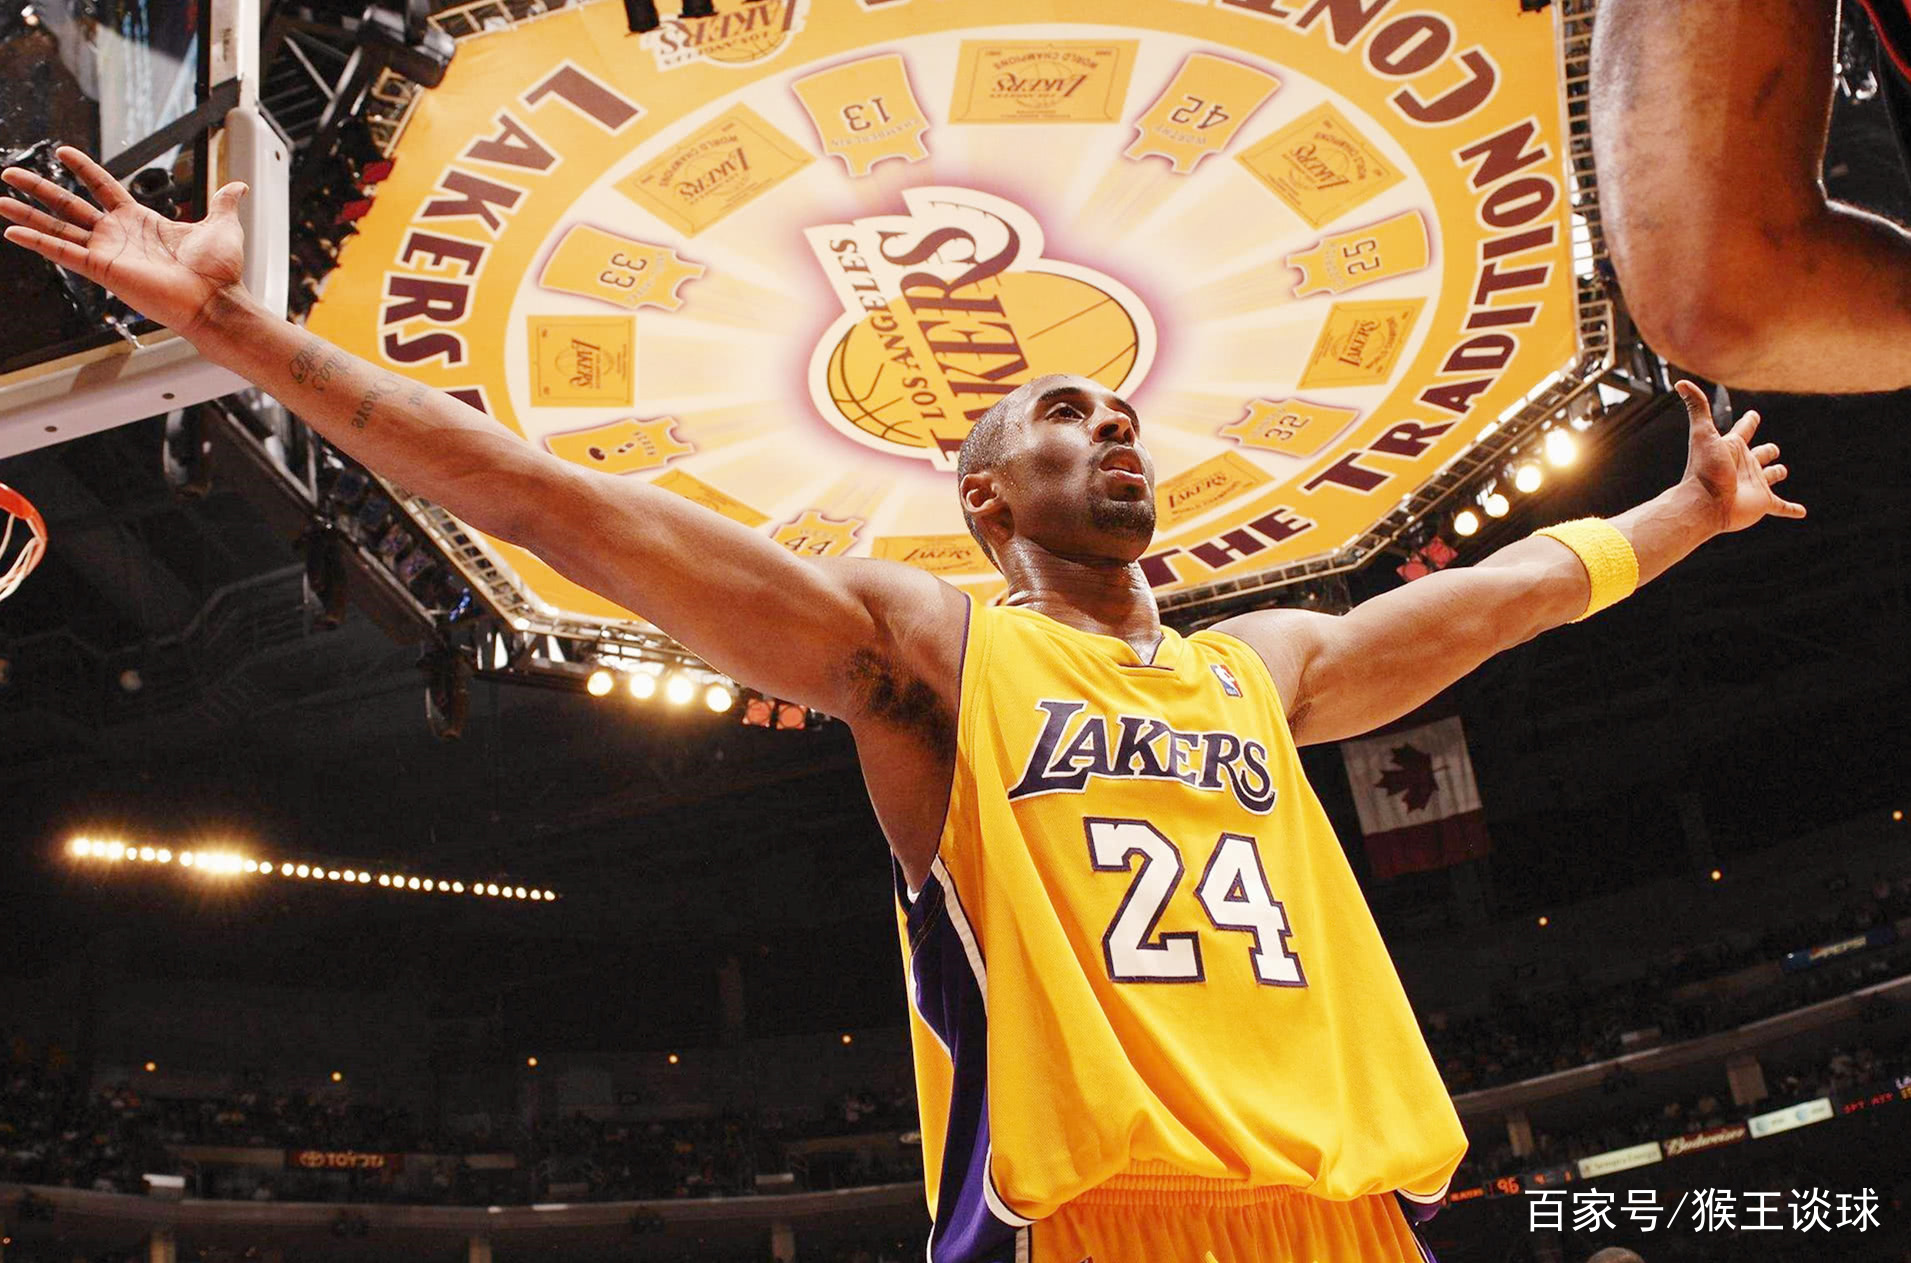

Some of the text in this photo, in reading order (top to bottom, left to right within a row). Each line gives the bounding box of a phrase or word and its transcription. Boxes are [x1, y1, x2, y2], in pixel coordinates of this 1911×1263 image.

[657, 0, 796, 52] LAKERS
[994, 72, 1088, 97] LAKERS
[842, 96, 891, 132] 13
[1171, 95, 1230, 130] 42
[675, 147, 751, 198] LAKERS
[1294, 143, 1352, 190] LAKERS
[380, 60, 645, 368] LAKERS
[599, 252, 648, 289] 33
[1343, 239, 1380, 275] 25
[830, 238, 946, 420] LOS ANGELES
[1300, 117, 1560, 494] TRADITION
[877, 199, 1029, 461] KERS
[1338, 319, 1381, 368] LAKERS
[570, 338, 601, 388] LAKERS
[1264, 414, 1310, 441] 32
[1168, 471, 1228, 508] LAKERS
[784, 535, 833, 556] 44
[1141, 505, 1317, 588] THE
[1008, 698, 1277, 815] LAKERS
[1083, 816, 1308, 988] 24
[1665, 1126, 1747, 1157] Budweiser
[1496, 1176, 1520, 1195] 96
